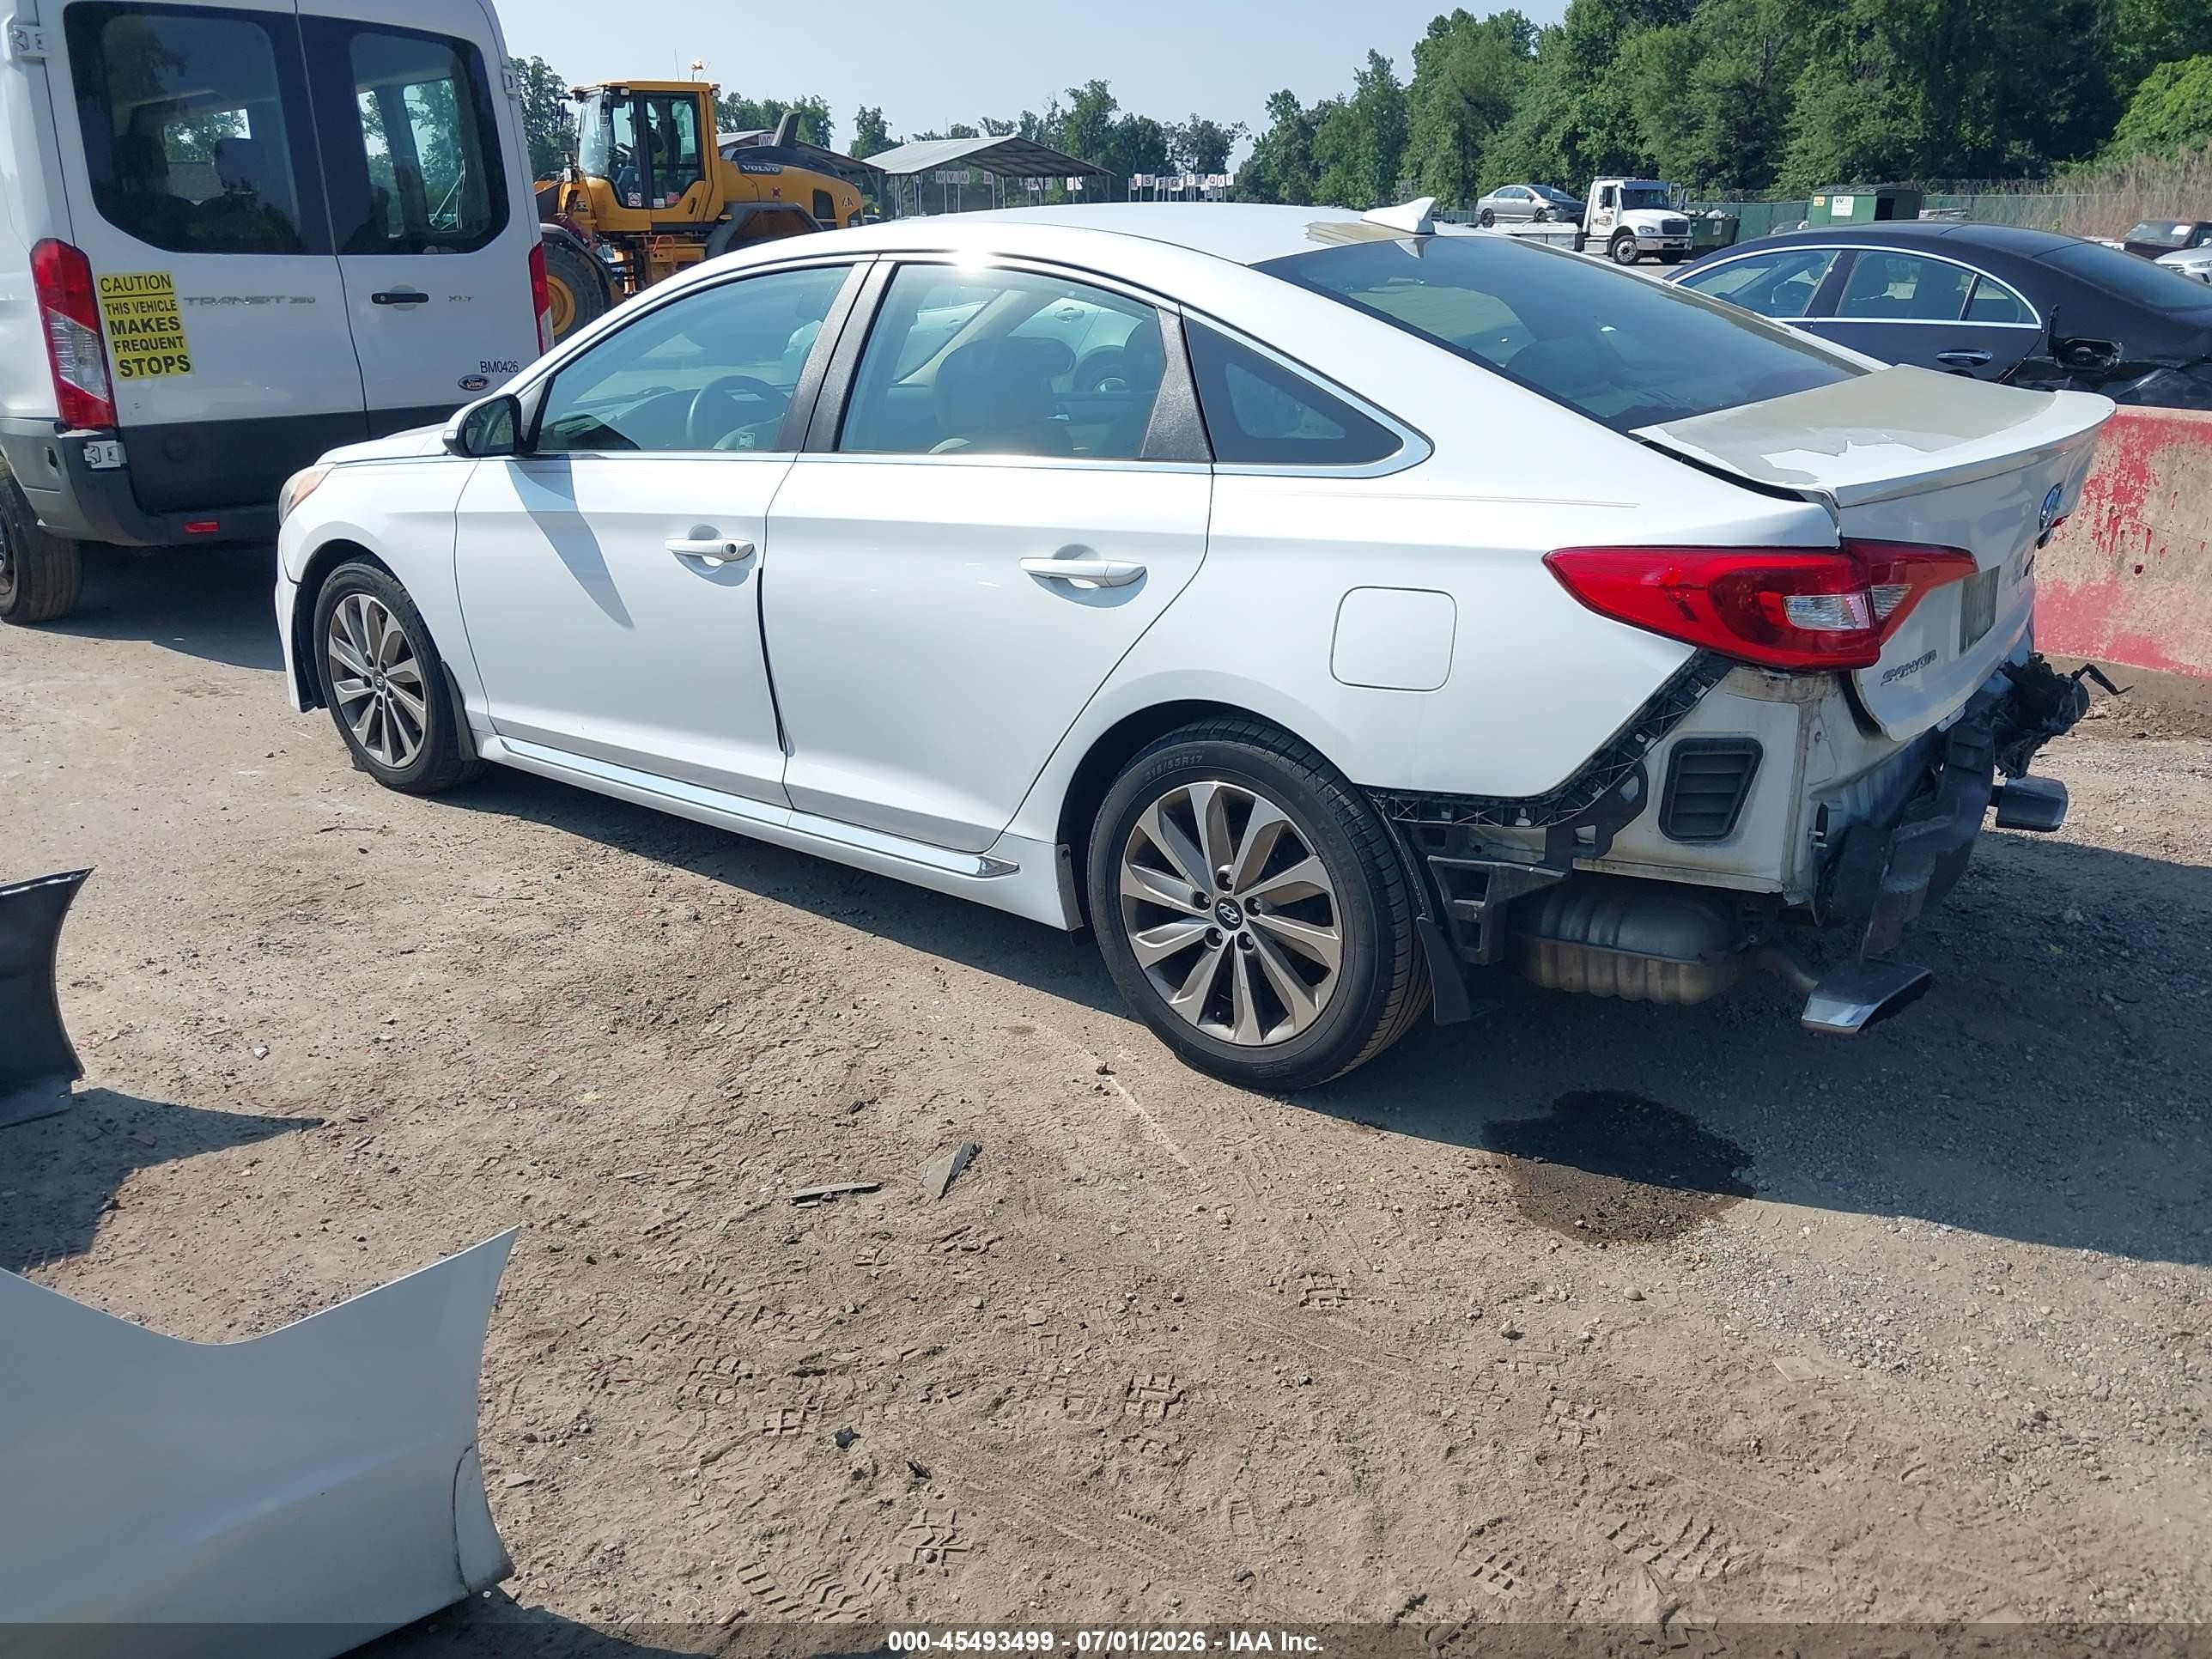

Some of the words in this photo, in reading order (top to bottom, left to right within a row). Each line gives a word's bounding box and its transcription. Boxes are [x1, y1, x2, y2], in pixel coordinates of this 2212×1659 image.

[741, 164, 779, 173] VOLVO
[100, 274, 172, 293] CAUTION
[104, 302, 130, 316] THIS
[131, 299, 178, 313] VEHICLE
[183, 295, 286, 306] TRANSIT
[109, 315, 180, 336] MAKES
[112, 336, 184, 354] FREQUENT
[118, 355, 191, 378] STOPS
[480, 361, 519, 374] BM0426
